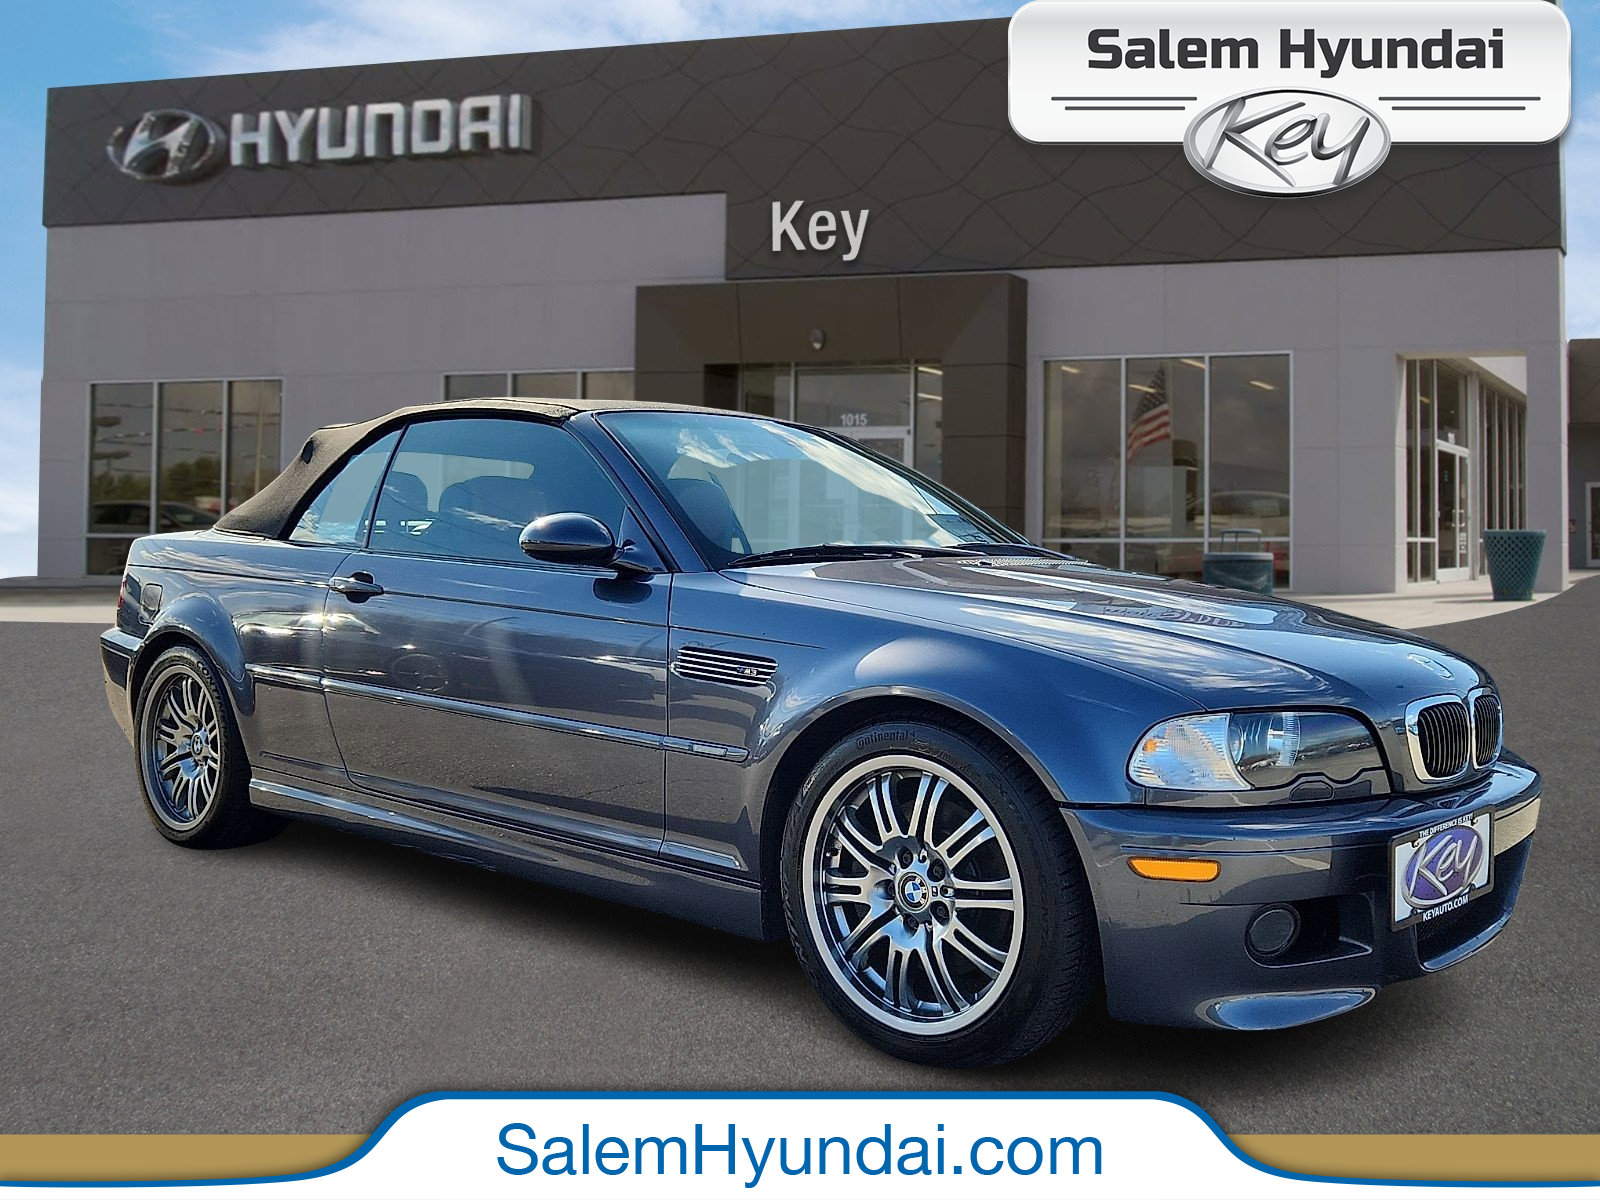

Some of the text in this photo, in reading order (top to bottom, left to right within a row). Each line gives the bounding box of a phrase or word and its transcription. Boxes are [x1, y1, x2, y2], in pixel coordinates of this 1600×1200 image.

[230, 93, 529, 167] HYUNDAI
[772, 199, 870, 262] Key
[840, 413, 868, 426] 1015
[1419, 828, 1430, 838] THE
[1430, 818, 1458, 835] DIFFERENCE
[1408, 834, 1478, 898] Key
[1422, 894, 1469, 922] KEYAUTO.COM
